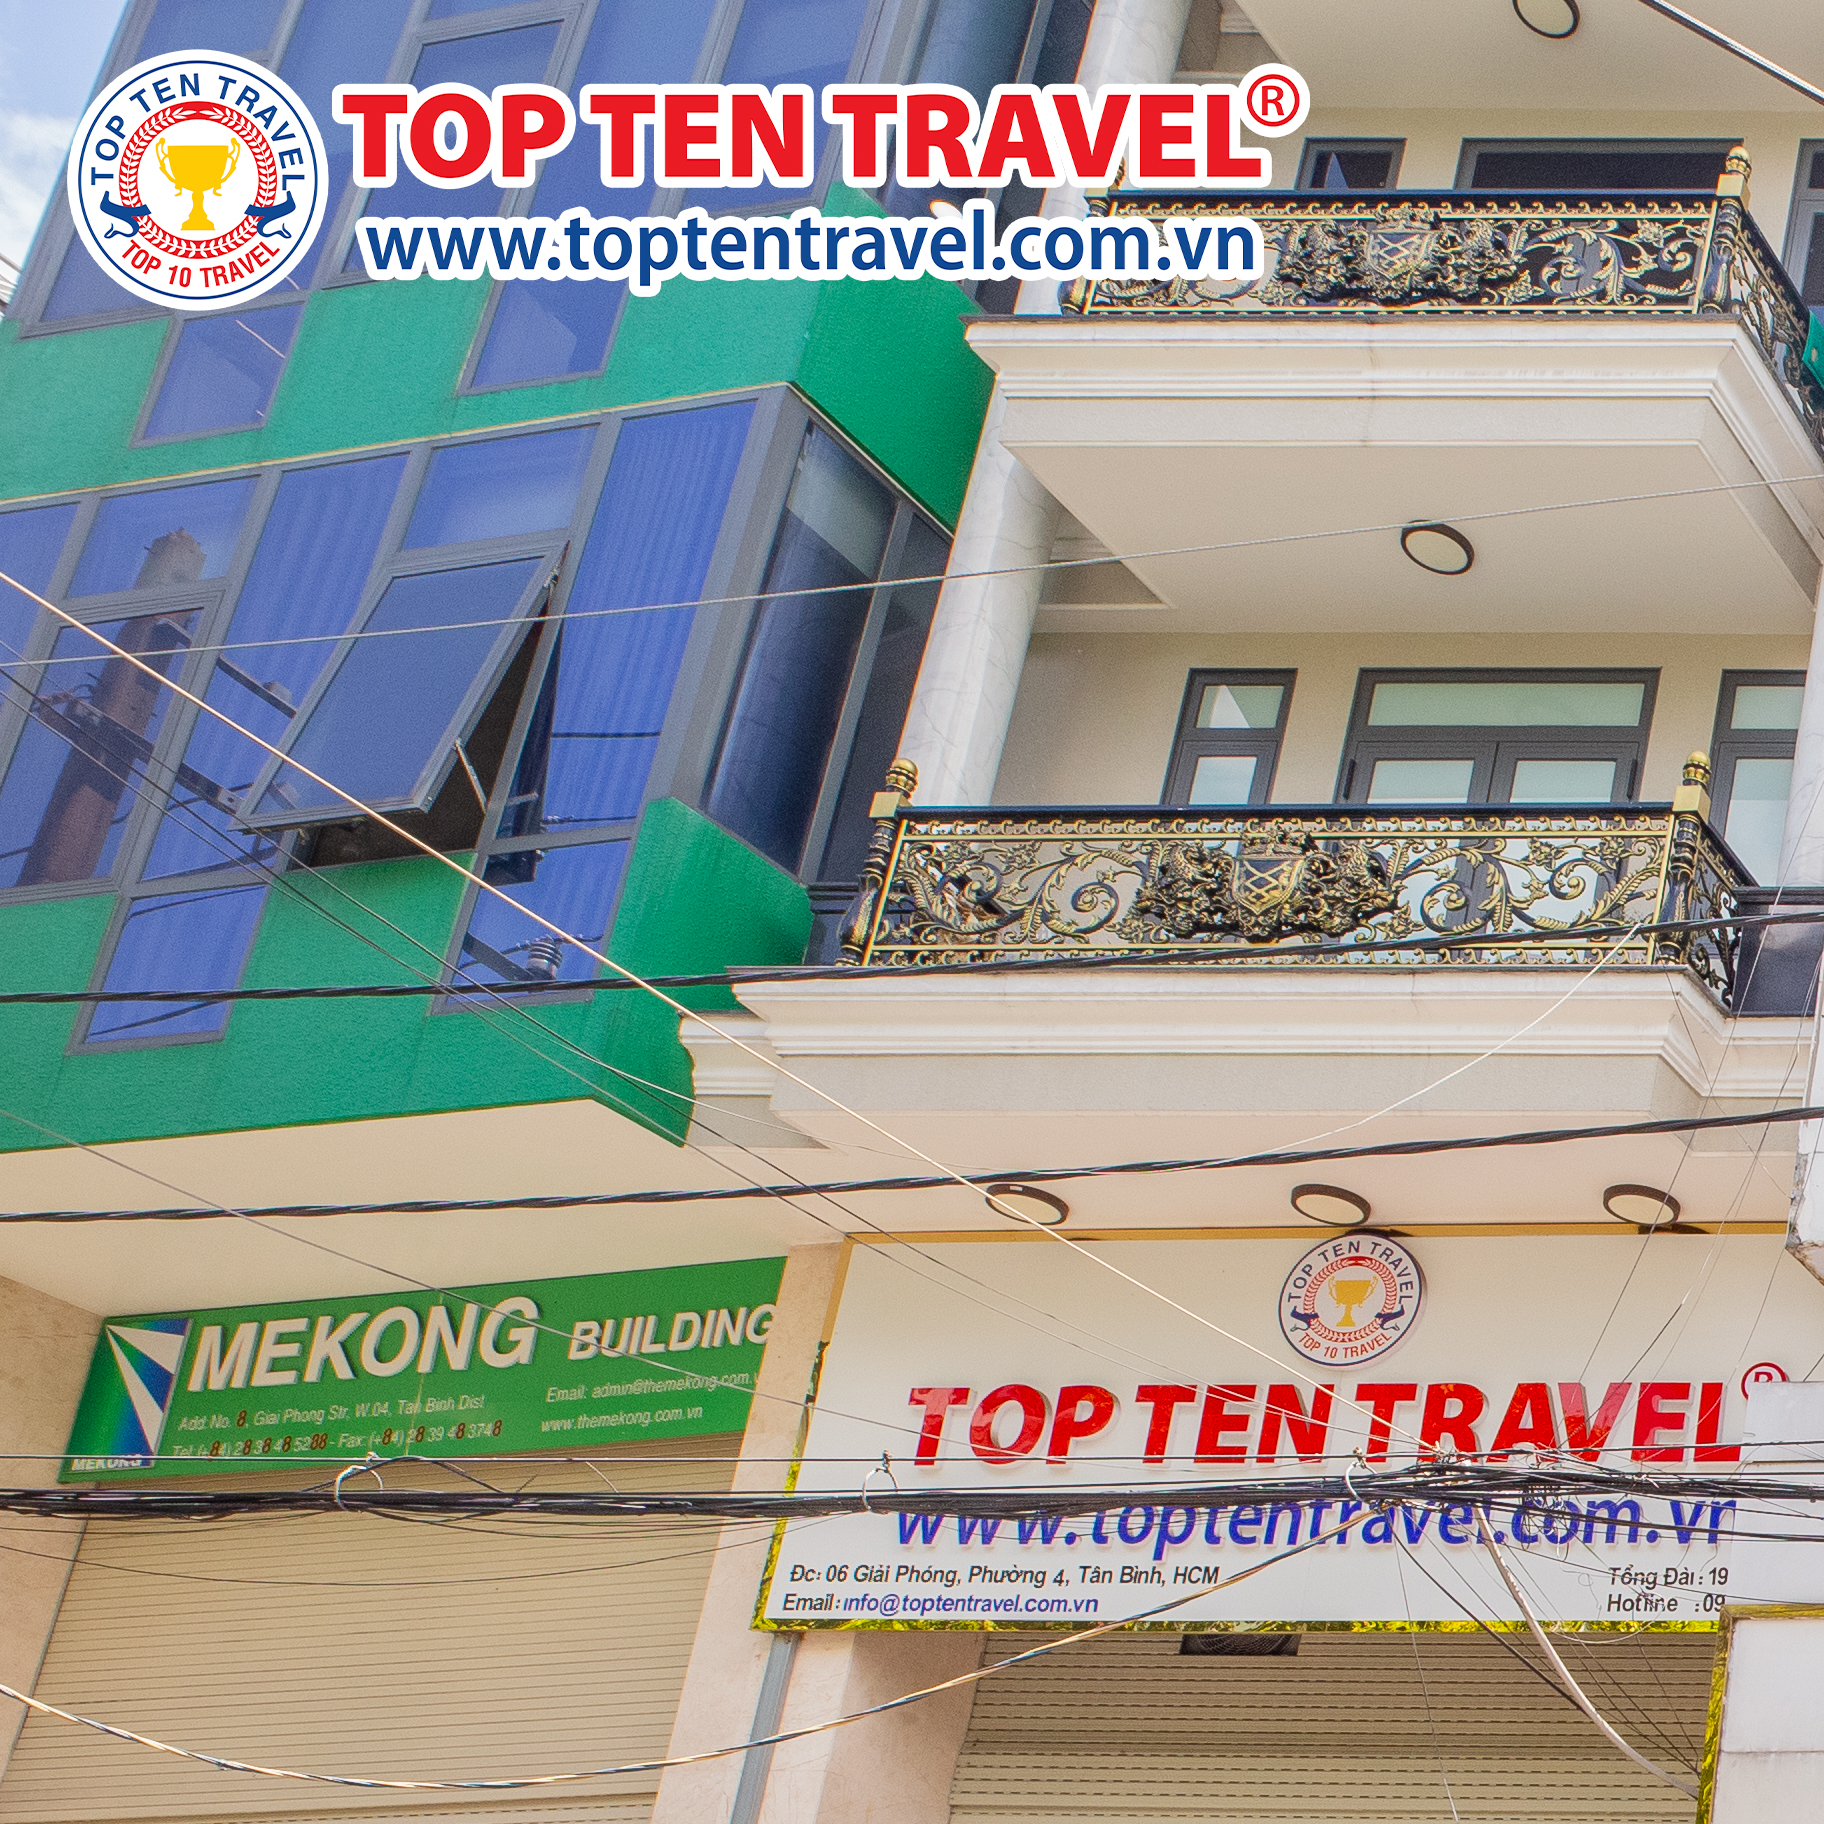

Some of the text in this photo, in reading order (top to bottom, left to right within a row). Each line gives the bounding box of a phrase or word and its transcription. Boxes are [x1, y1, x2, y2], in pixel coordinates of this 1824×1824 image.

[1287, 1240, 1413, 1304] TOP TEN TRAVEL
[188, 1295, 778, 1393] MEKONG BUILDING
[1298, 1332, 1392, 1359] TOP 10 TRAVEL
[907, 1386, 1120, 1466] TOP
[1134, 1383, 1337, 1464] TEN
[826, 1565, 848, 1583] 06
[853, 1563, 890, 1584] Giải
[897, 1564, 961, 1588] Phóng,
[968, 1563, 1047, 1588] Phường
[1079, 1563, 1115, 1585] Tân
[1173, 1565, 1220, 1585] HCM
